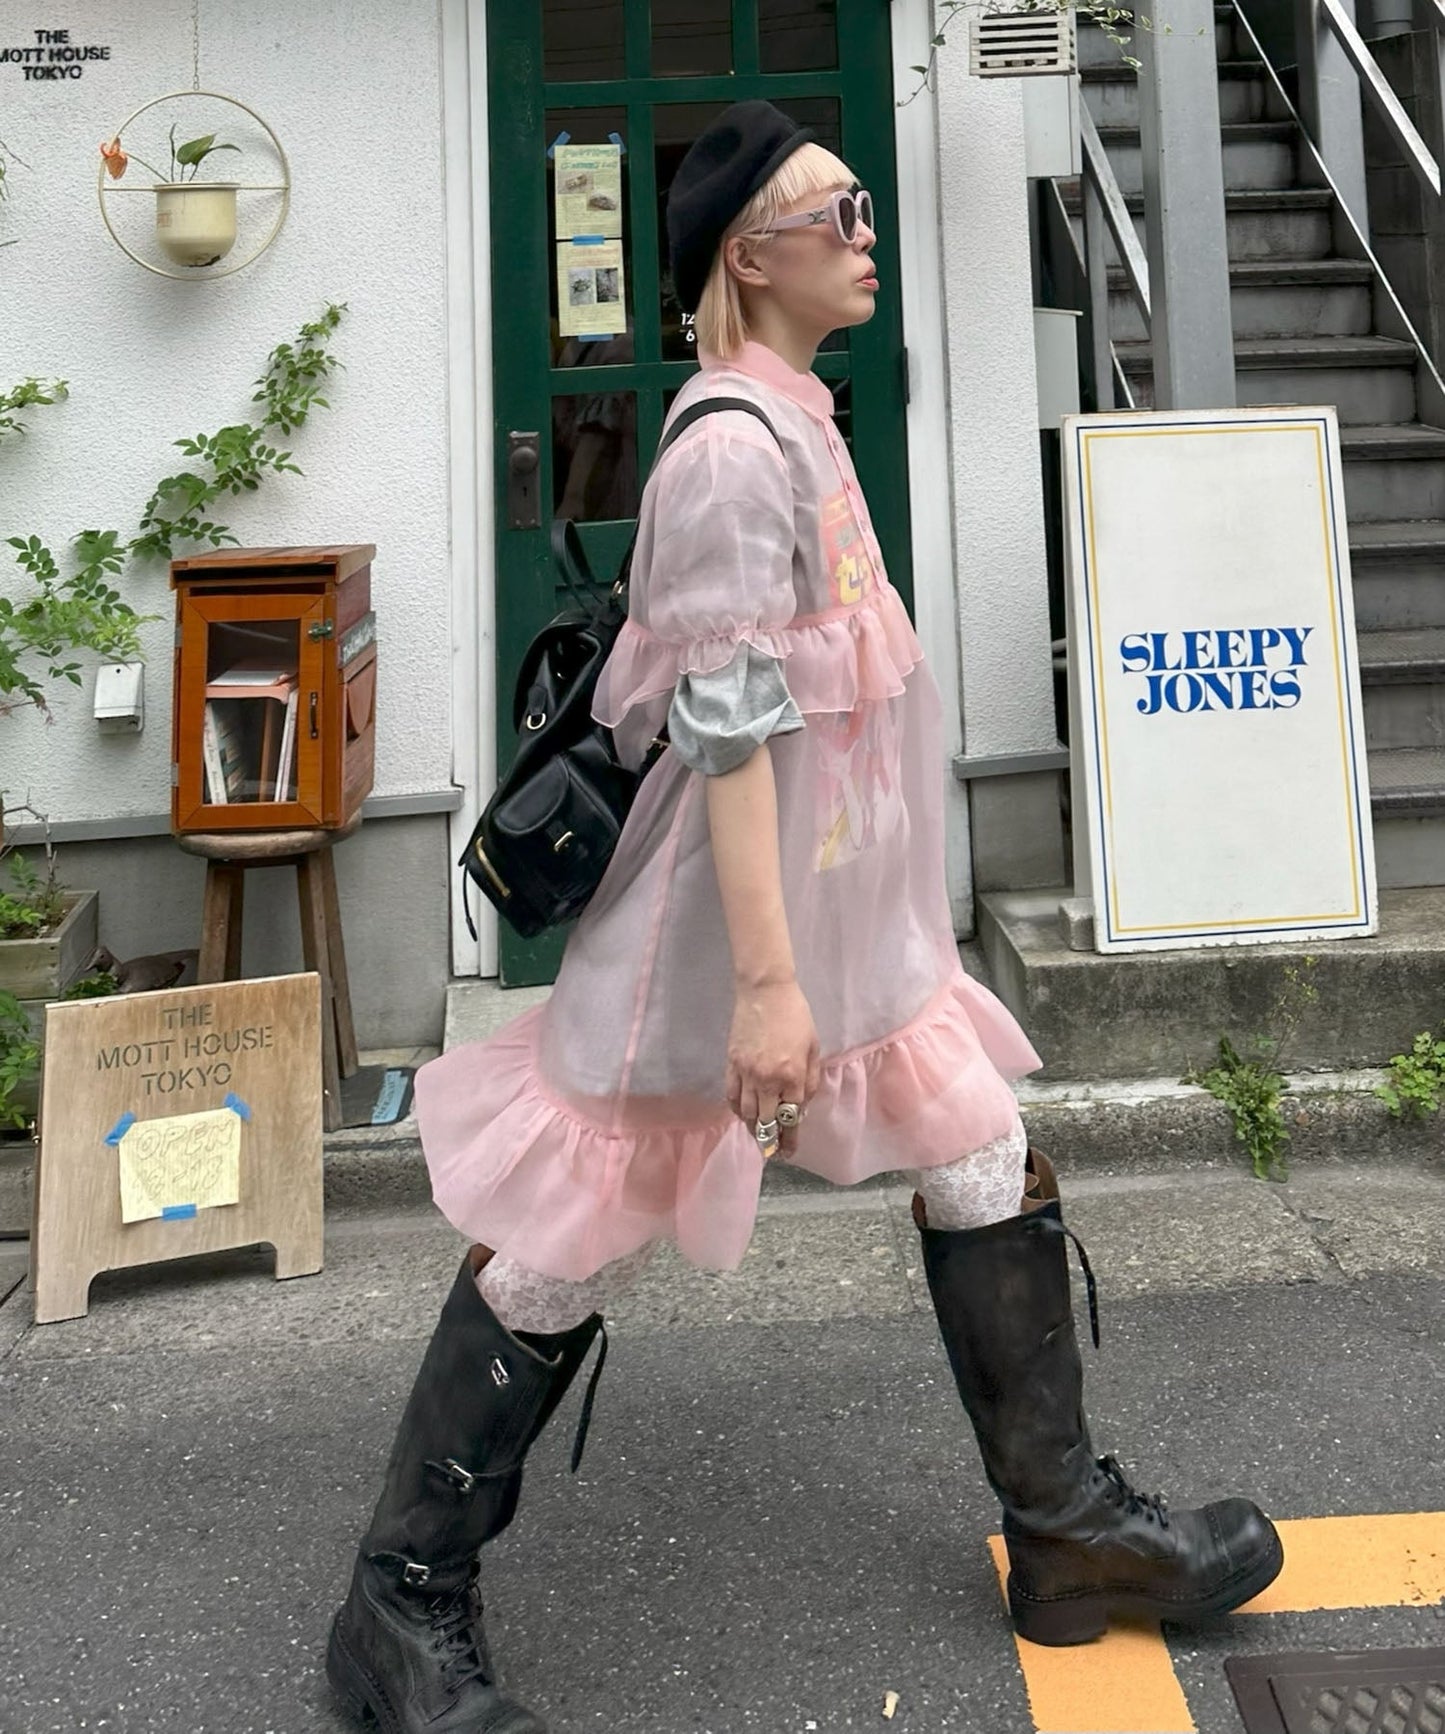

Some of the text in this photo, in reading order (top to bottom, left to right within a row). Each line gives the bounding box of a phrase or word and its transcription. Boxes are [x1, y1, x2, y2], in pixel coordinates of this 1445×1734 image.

[34, 29, 69, 44] THE
[49, 46, 111, 62] HOUSE
[22, 65, 82, 80] TOKYO
[1120, 626, 1315, 674] SLEEPY
[1137, 669, 1301, 715] JONES
[162, 1003, 214, 1029] THE
[97, 1026, 274, 1071] MOTT HOUSE
[141, 1063, 232, 1095] TOKYO
[136, 1118, 235, 1160] OPEN
